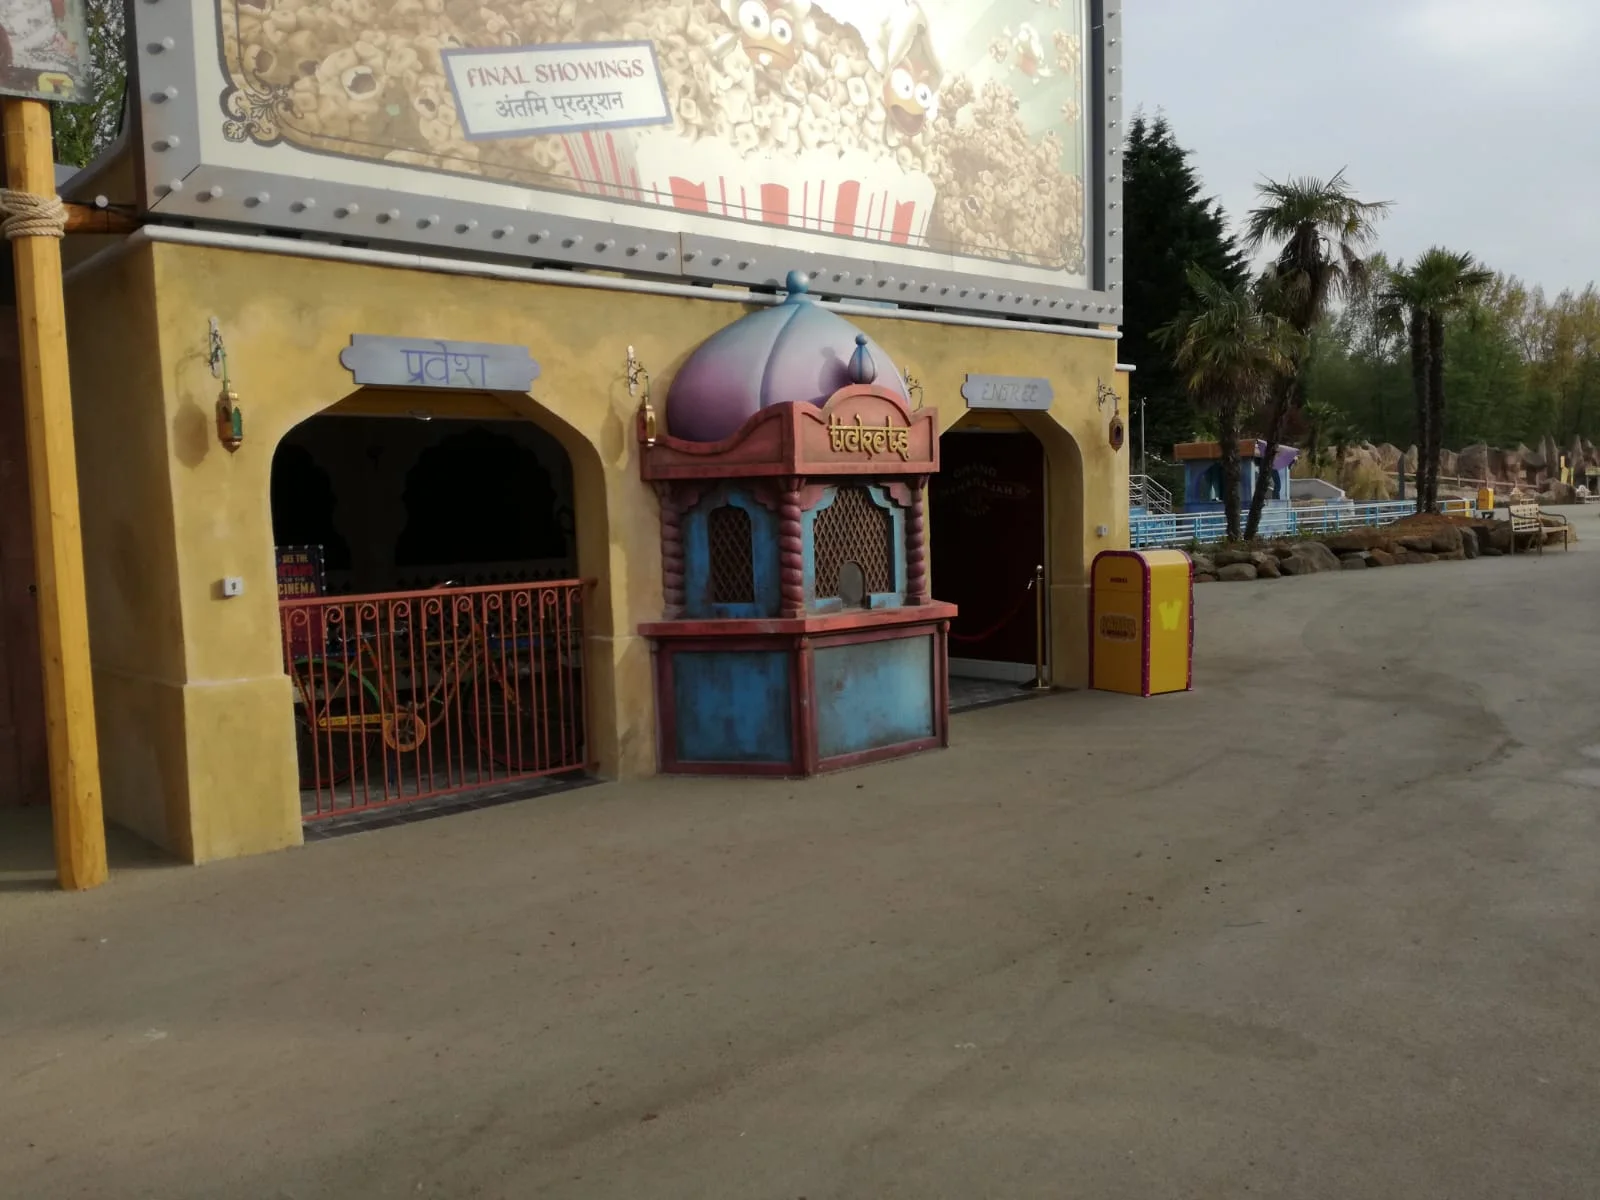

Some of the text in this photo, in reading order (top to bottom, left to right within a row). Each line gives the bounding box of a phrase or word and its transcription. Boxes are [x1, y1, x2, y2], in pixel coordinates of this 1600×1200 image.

[466, 59, 645, 89] FINAL SHOWINGS
[278, 582, 317, 595] CINEMA
